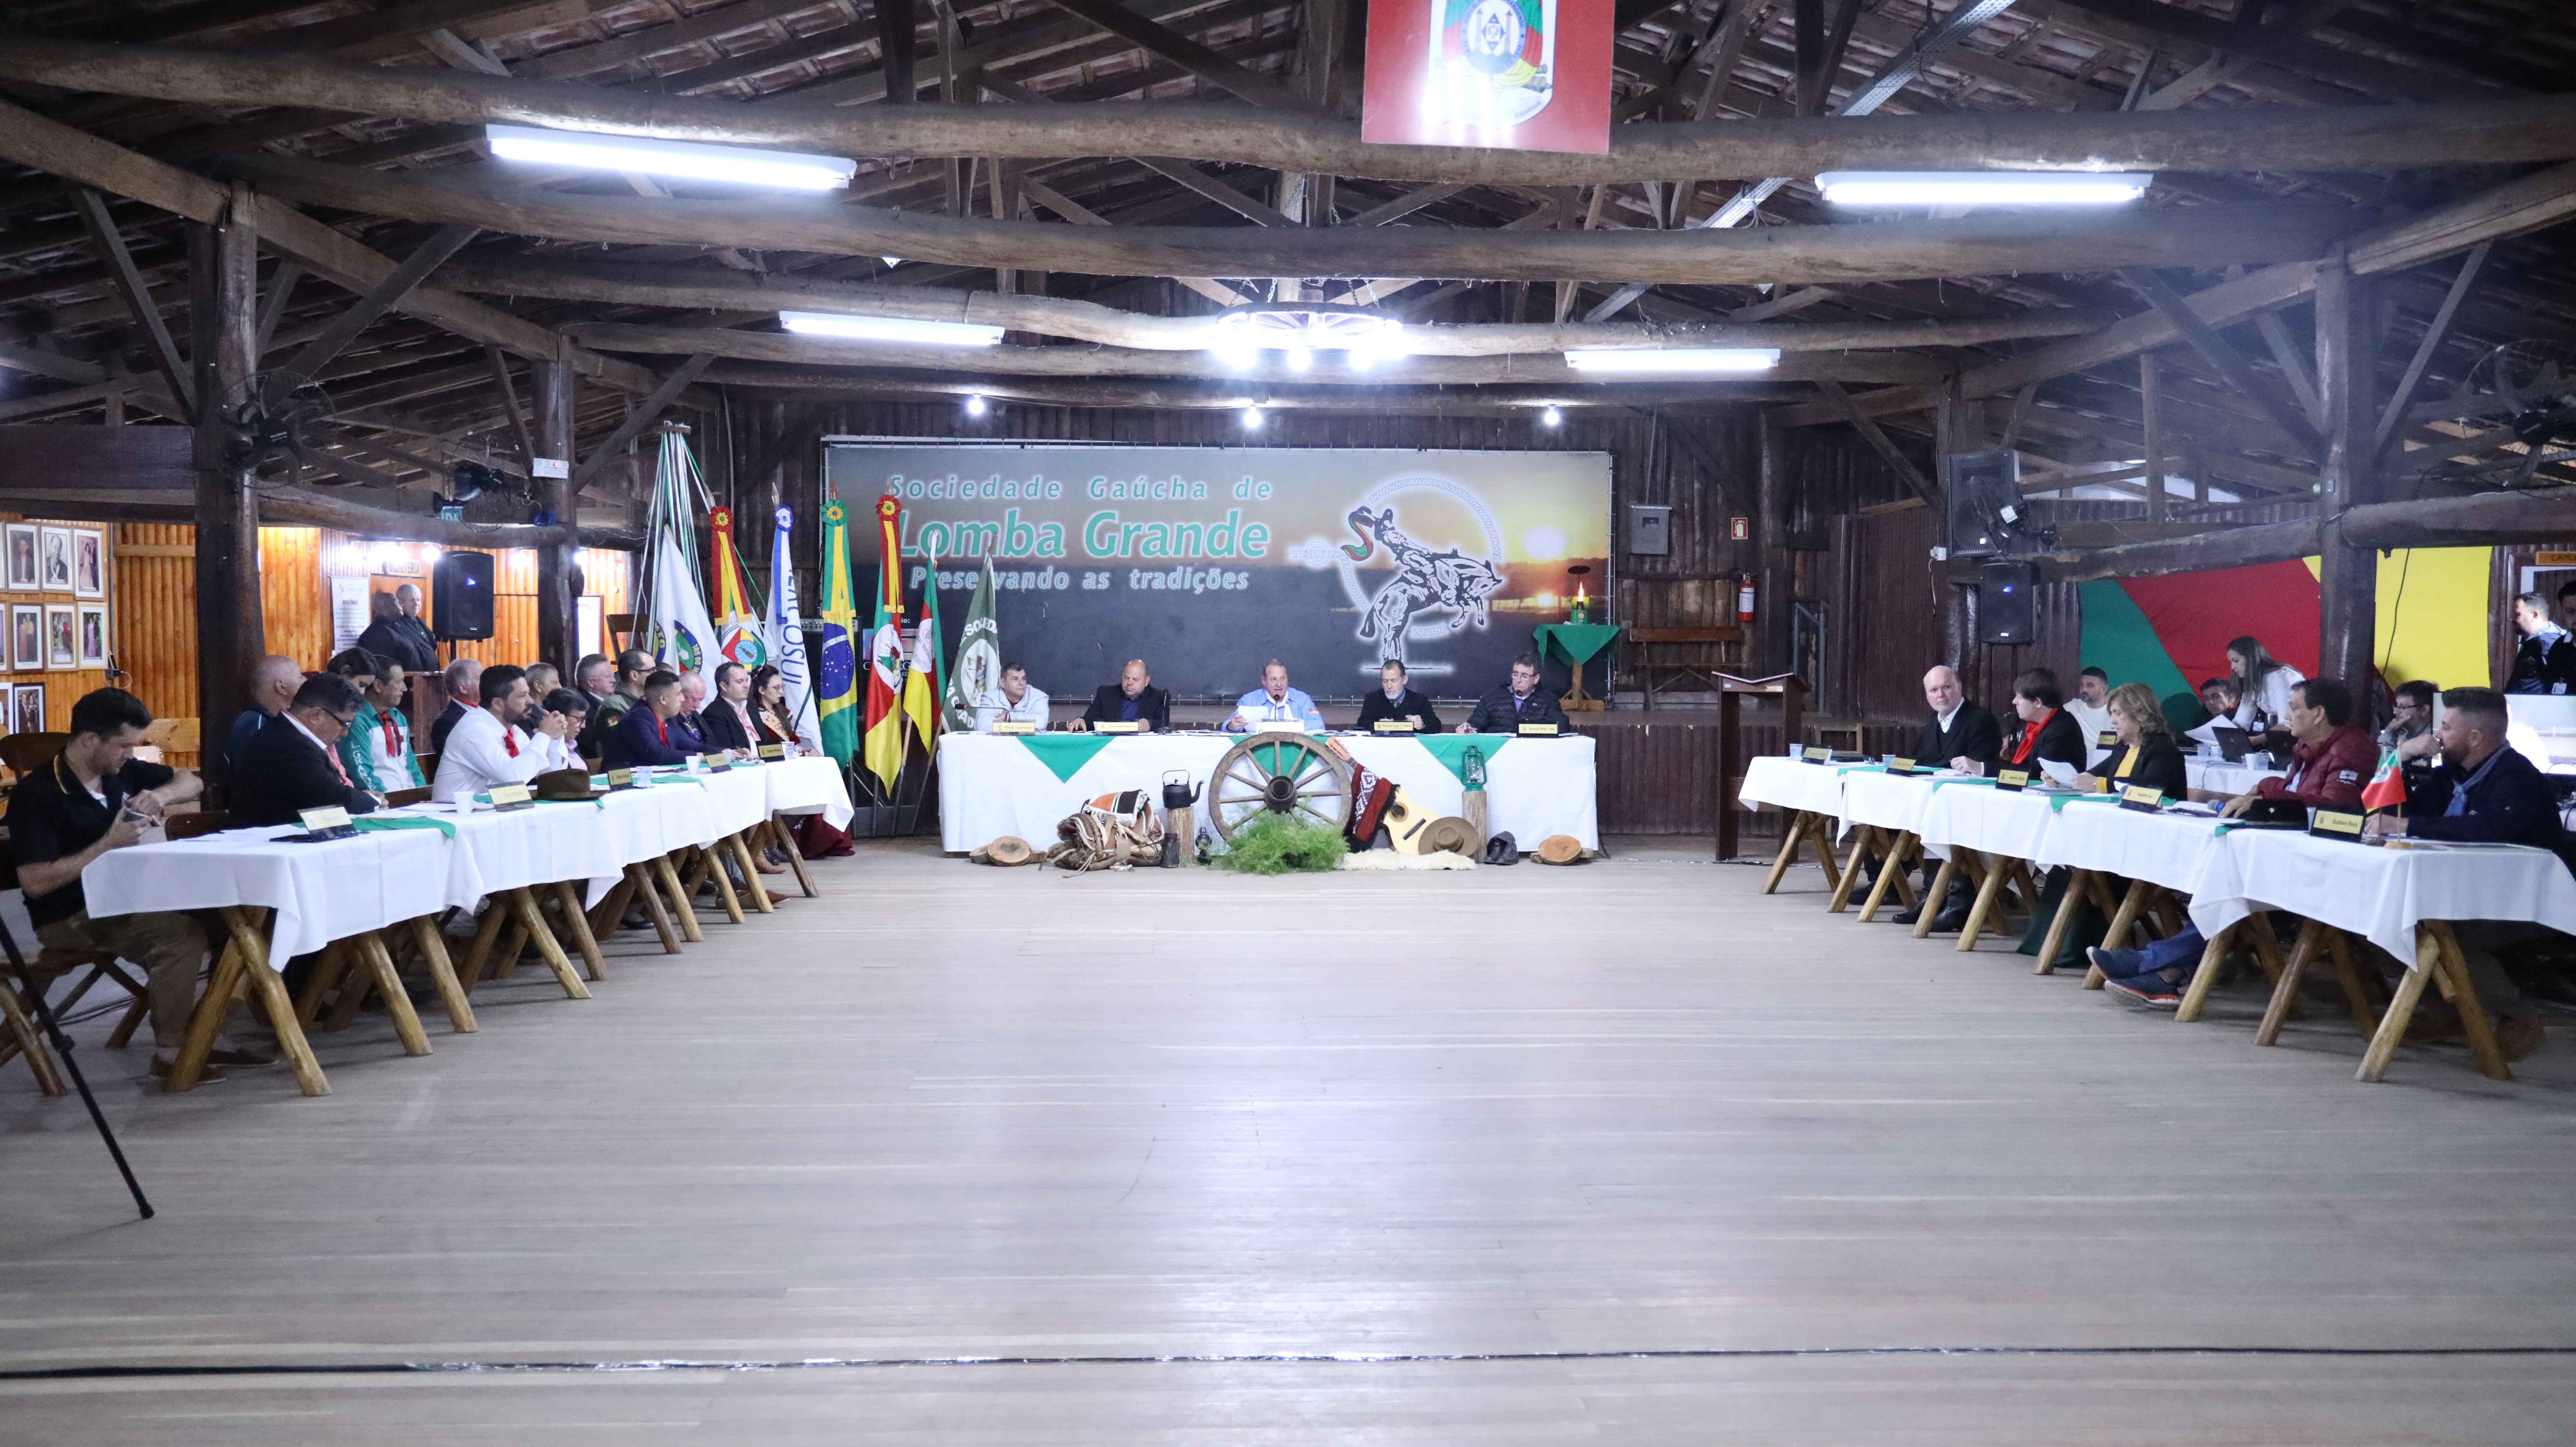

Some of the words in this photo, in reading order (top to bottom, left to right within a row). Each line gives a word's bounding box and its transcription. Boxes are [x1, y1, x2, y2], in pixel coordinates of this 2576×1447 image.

[891, 476, 1060, 498] Sociedade
[1090, 477, 1205, 498] Gaúcha
[1235, 477, 1270, 498] de
[899, 510, 1064, 556] Lomba
[1085, 510, 1268, 557] Grande
[911, 567, 1069, 588] Pesevando
[1083, 573, 1109, 588] as
[1130, 566, 1249, 594] tradições
[352, 750, 377, 790] GRANDE
